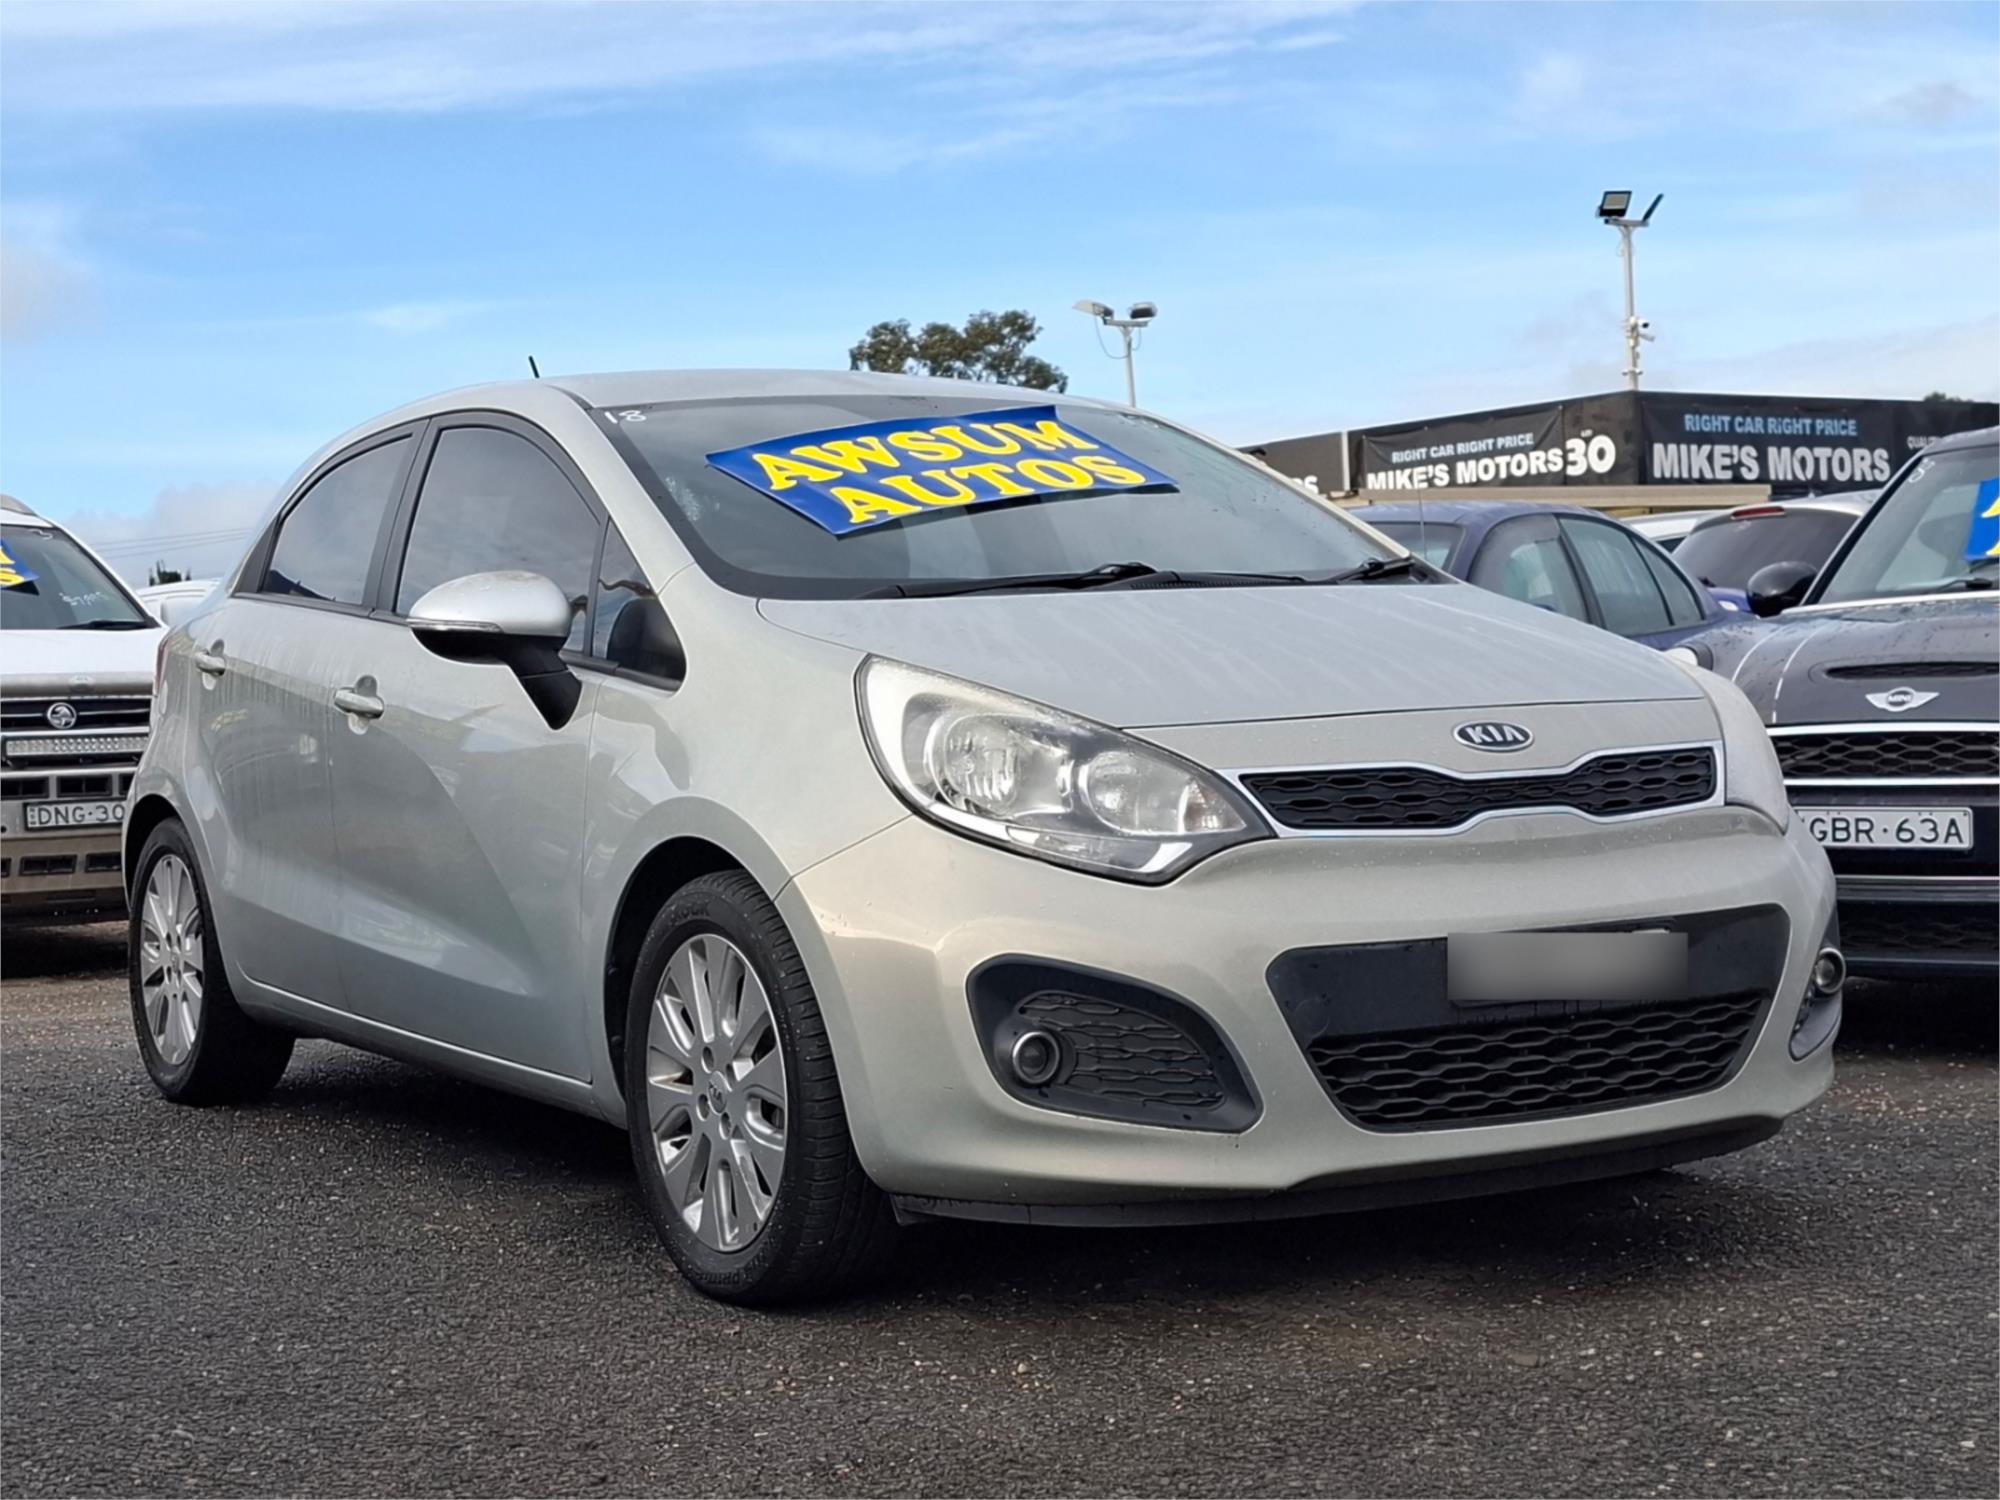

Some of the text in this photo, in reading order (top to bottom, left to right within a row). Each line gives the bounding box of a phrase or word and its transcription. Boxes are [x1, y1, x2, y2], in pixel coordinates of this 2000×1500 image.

[1683, 413, 1731, 433] RIGHT
[1734, 416, 1764, 434] CAR
[1815, 418, 1858, 436] PRICE
[752, 420, 1099, 490] AWSUM
[1366, 447, 1565, 490] MIKE'S MOTORS
[1391, 432, 1535, 464] RIGHT CAR RIGHT PRICE
[1565, 434, 1617, 477] 30
[1652, 442, 1760, 481] MIKE'S
[1767, 446, 1891, 482] MOTORS
[830, 455, 1147, 524] AUTOS
[1465, 725, 1526, 744] KIA
